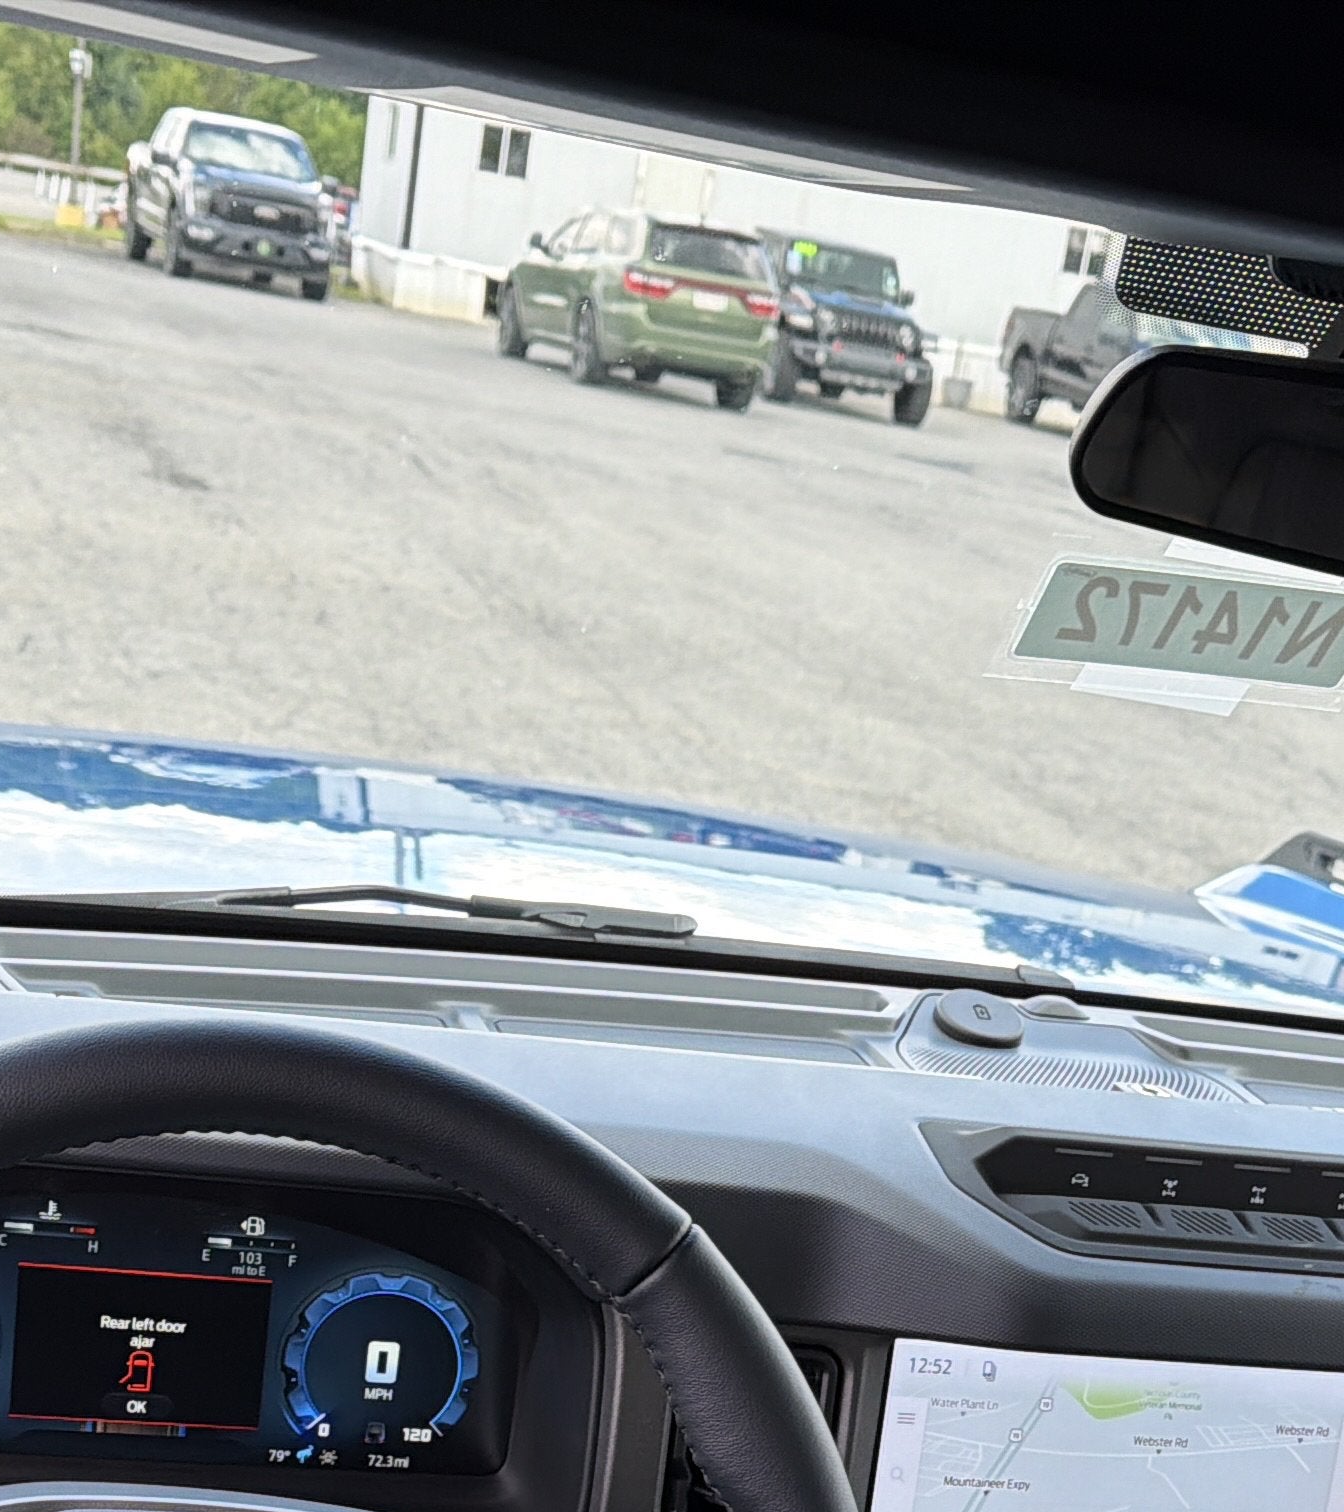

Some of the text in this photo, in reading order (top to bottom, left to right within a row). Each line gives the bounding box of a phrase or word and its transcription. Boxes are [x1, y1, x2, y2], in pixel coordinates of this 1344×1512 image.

[87, 1240, 99, 1254] H
[201, 1249, 211, 1262] E
[238, 1251, 262, 1266] 103
[100, 1315, 187, 1334] Rear left door
[129, 1335, 155, 1350] ajar
[364, 1340, 401, 1384] 0
[909, 1357, 953, 1375] 12:52
[364, 1387, 393, 1401] MPH
[126, 1400, 147, 1414] OK
[931, 1397, 999, 1410] Water Plant Ln
[317, 1423, 330, 1438] 0
[402, 1427, 433, 1443] 120
[1276, 1424, 1329, 1438] Webster Rd
[1133, 1436, 1189, 1449] Webster Rd
[943, 1475, 1031, 1492] Mountaineer Expy
